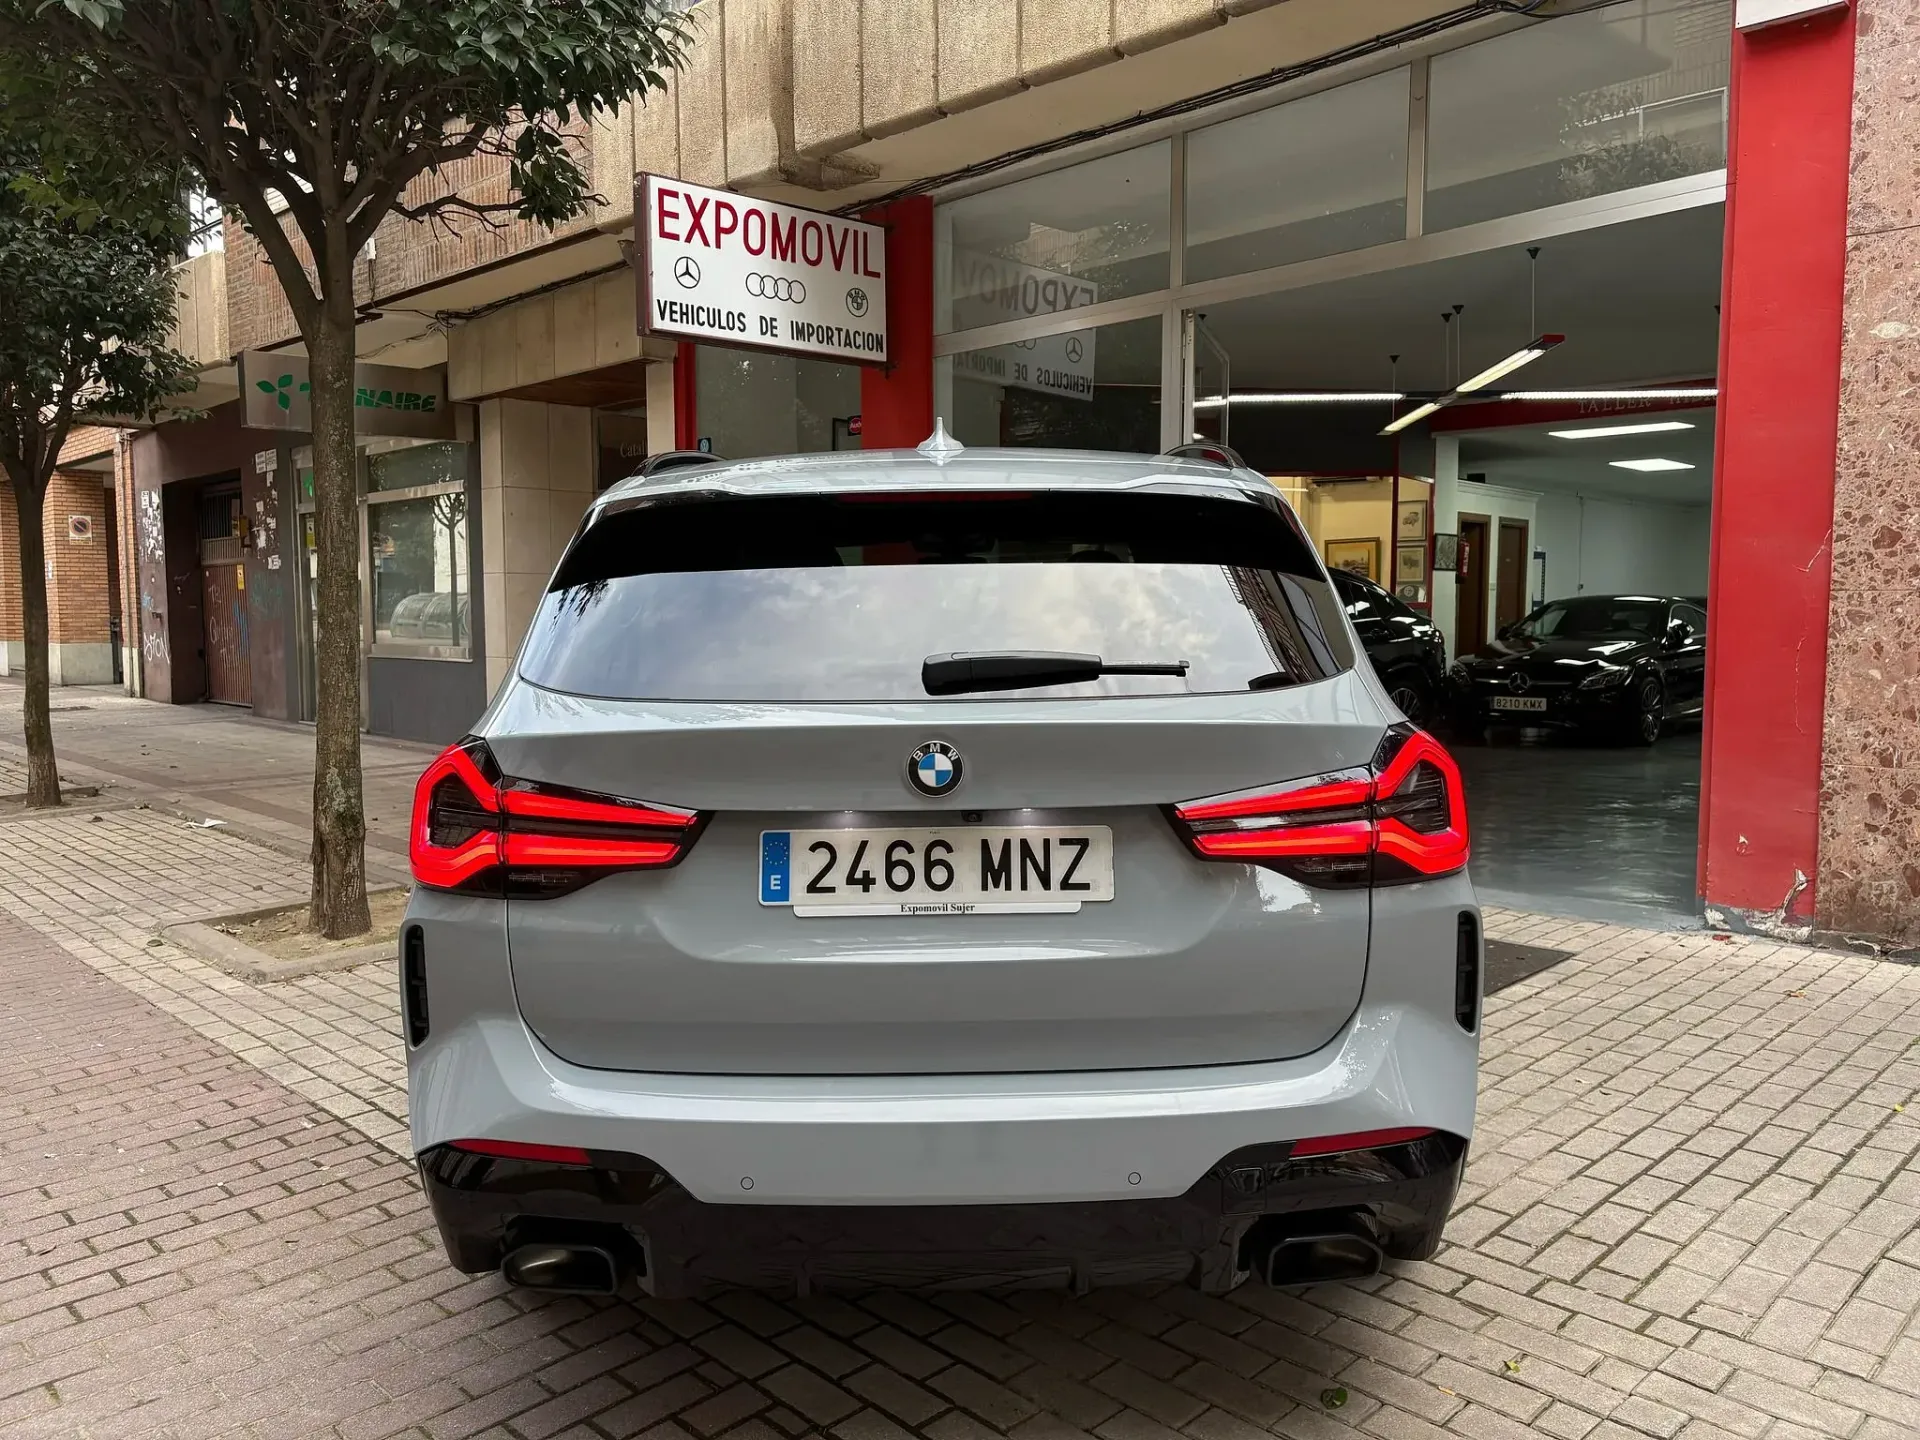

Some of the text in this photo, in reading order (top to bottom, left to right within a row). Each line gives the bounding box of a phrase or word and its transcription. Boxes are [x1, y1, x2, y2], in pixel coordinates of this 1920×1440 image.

[657, 187, 881, 279] EXPOMOVIL
[656, 298, 884, 353] VEHICULOS DE IMPORTACION
[913, 743, 959, 761] BMW
[770, 837, 1091, 894] E 2466 MNZ
[900, 903, 976, 915] Expomovil Sujer
